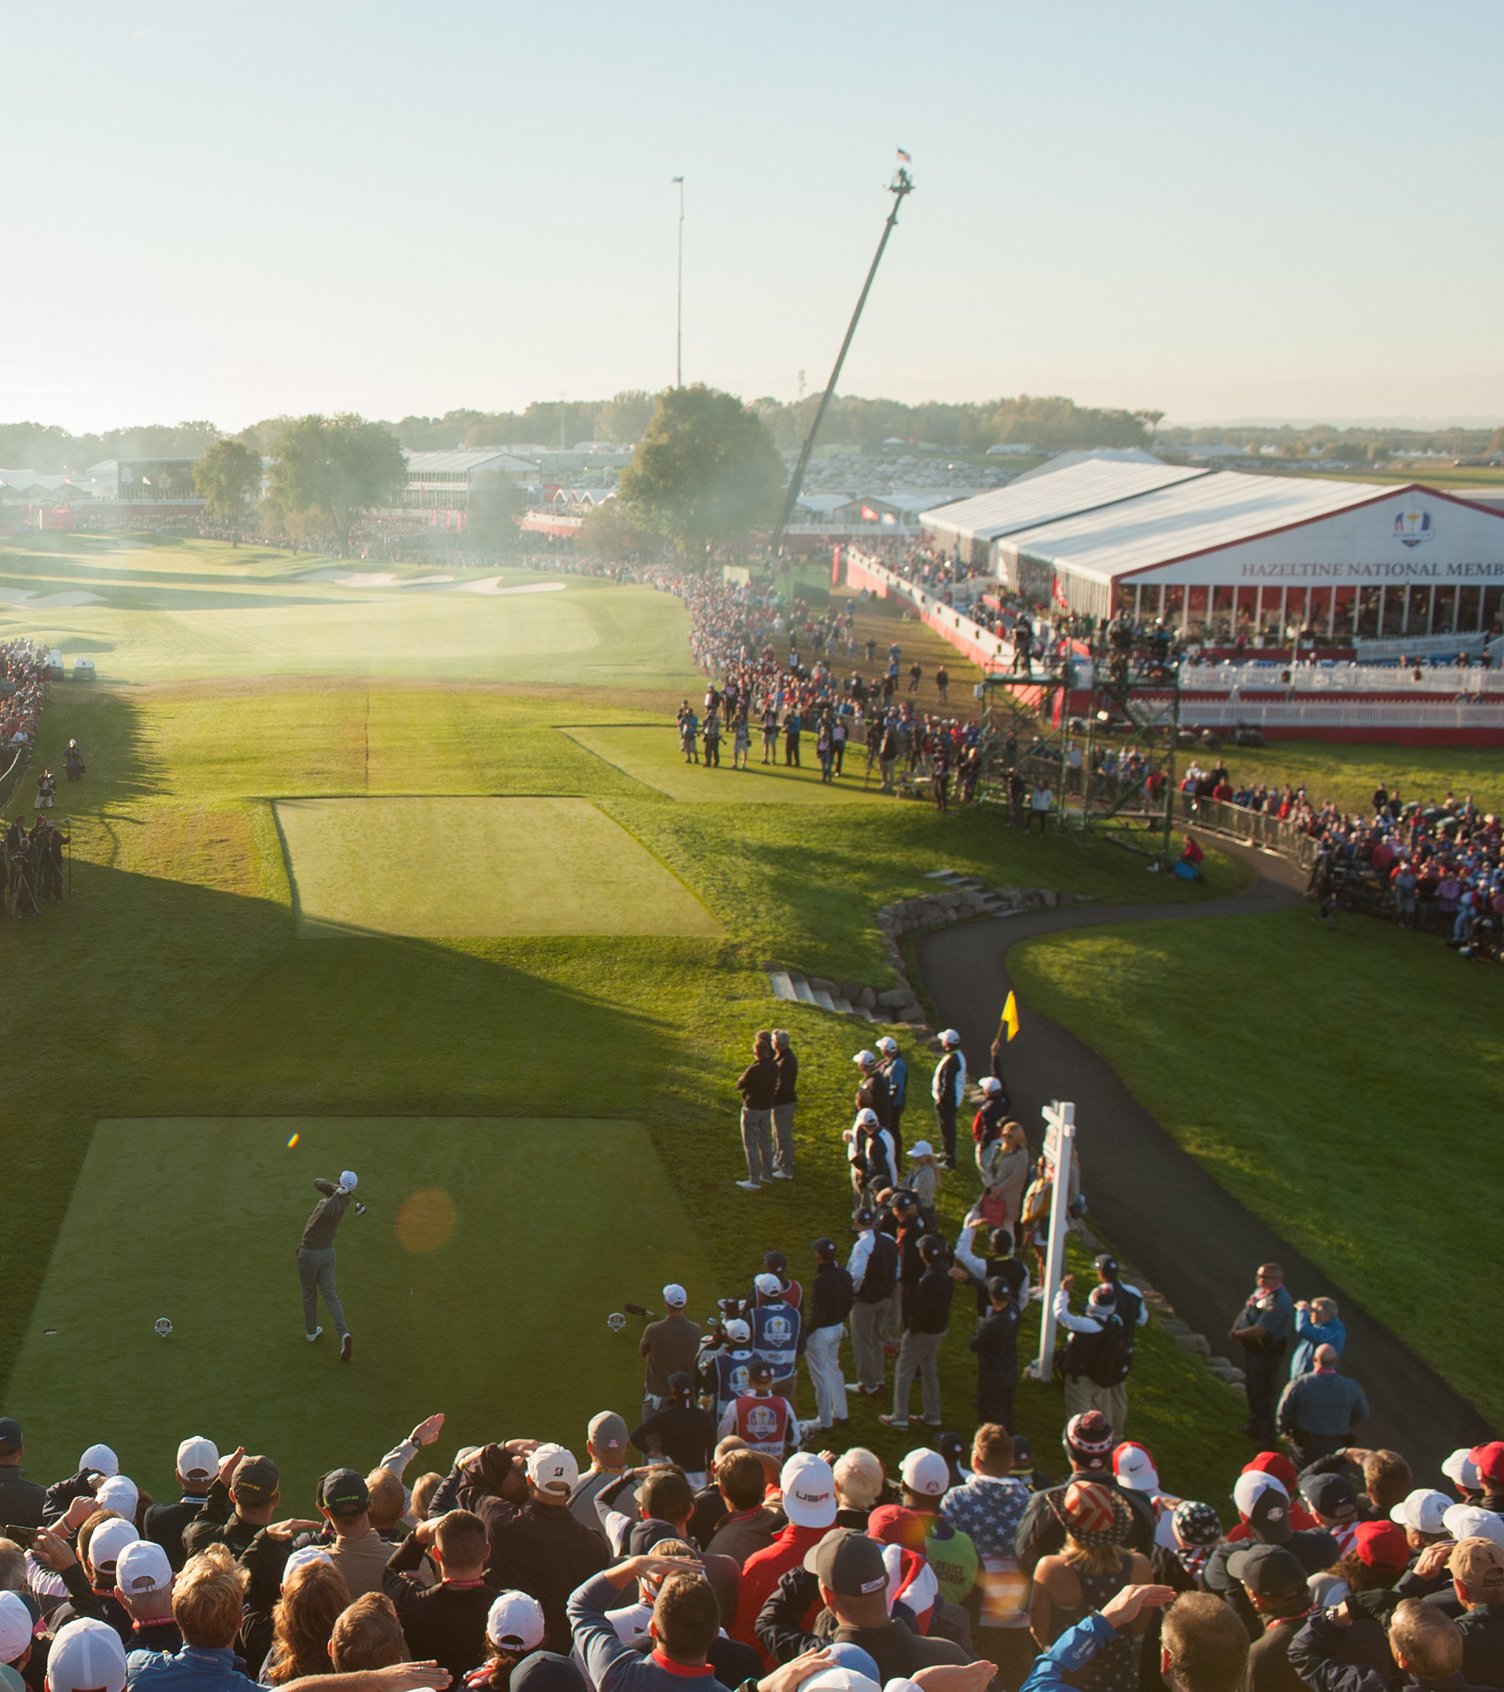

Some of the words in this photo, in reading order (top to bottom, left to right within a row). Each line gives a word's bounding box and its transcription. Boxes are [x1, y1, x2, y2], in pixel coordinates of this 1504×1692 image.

[1242, 562, 1341, 577] HAZELTINE
[1347, 562, 1443, 577] NATIONAL
[795, 1490, 829, 1503] USA
